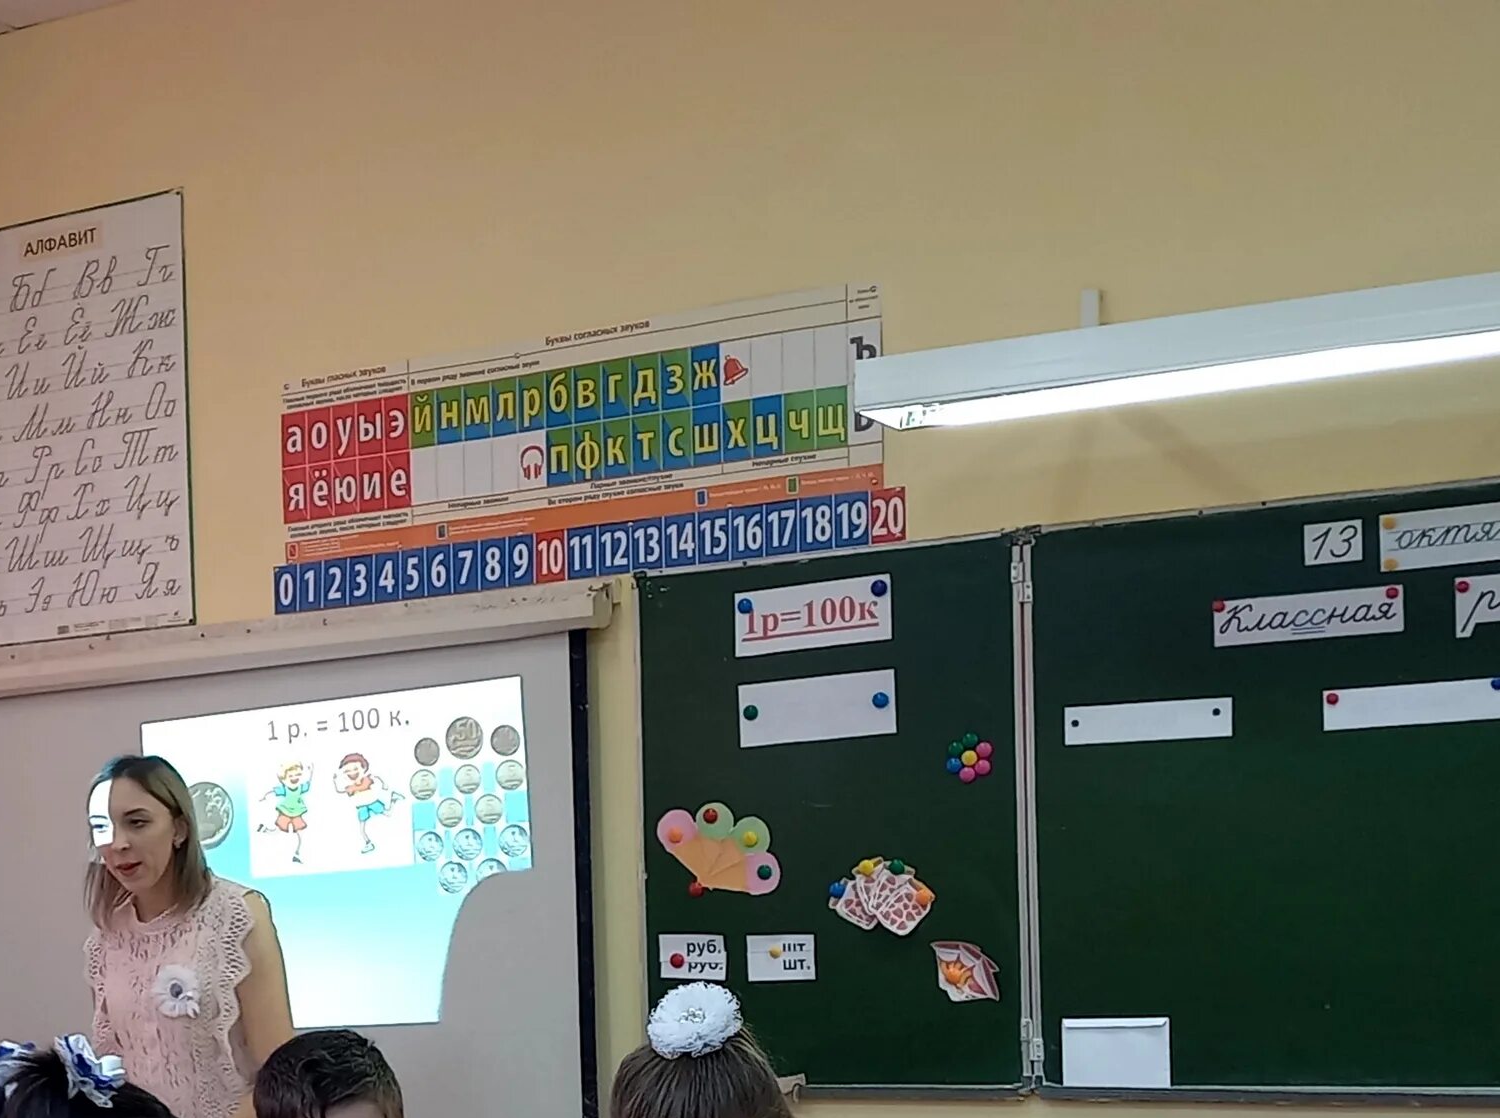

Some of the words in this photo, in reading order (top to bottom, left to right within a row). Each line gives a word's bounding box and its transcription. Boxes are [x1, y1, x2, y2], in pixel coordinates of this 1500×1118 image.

[24, 228, 96, 257] АЛФАВИТ
[10, 268, 57, 312] Бб
[72, 256, 117, 299] Вв
[137, 245, 173, 287] Гг
[18, 317, 47, 354] Ее
[64, 302, 92, 345] Ёё
[105, 295, 176, 338] Жж
[5, 362, 50, 400] Ии
[62, 346, 109, 389] Йй
[127, 339, 176, 379] Кк
[13, 403, 75, 442] Мм
[87, 390, 132, 429] Нн
[145, 382, 176, 420] Оо
[414, 394, 431, 434] й
[441, 402, 458, 429] н
[466, 397, 489, 425] м
[497, 392, 513, 422] л
[523, 388, 541, 427] р
[549, 372, 566, 412] б
[577, 380, 597, 408] в
[607, 374, 621, 403] г
[633, 368, 656, 407] д
[666, 364, 684, 394] з
[692, 359, 717, 390] ж
[286, 425, 302, 453] а
[311, 422, 328, 449] о
[337, 418, 353, 455] у
[360, 412, 381, 442] ы
[389, 409, 405, 438] э
[550, 445, 568, 474] п
[576, 432, 599, 479] ф
[607, 437, 625, 466] к
[637, 432, 654, 460] т
[668, 428, 683, 456] с
[693, 423, 719, 454] ш
[727, 419, 746, 449] х
[756, 414, 778, 450] ц
[788, 408, 809, 439] ч
[817, 404, 845, 442] щ
[25, 446, 64, 500] Рр
[75, 439, 103, 476] Сс
[114, 427, 178, 469] Тт
[14, 490, 59, 543] Фф
[67, 482, 110, 520] Хх
[124, 473, 180, 520] Цц
[289, 483, 304, 511] я
[313, 469, 329, 507] ё
[334, 477, 357, 504] ю
[363, 471, 381, 500] и
[390, 468, 406, 496] е
[5, 533, 68, 572] Шш
[79, 523, 152, 569] Щщ
[280, 573, 294, 606] 0
[304, 570, 314, 602] 1
[328, 567, 342, 599] 2
[353, 564, 367, 596] 3
[379, 561, 395, 593] 4
[406, 557, 419, 591] 5
[431, 553, 445, 587] 6
[459, 550, 473, 584] 7
[485, 547, 500, 581] 8
[513, 543, 529, 578] 9
[538, 539, 563, 574] 10
[570, 534, 591, 570] 11
[601, 531, 627, 568] 12
[634, 527, 659, 564] 13
[666, 522, 694, 559] 14
[700, 518, 726, 555] 15
[733, 514, 761, 550] 16
[768, 510, 796, 547] 17
[802, 505, 831, 543] 18
[837, 500, 867, 540] 19
[872, 495, 905, 536] 20
[1312, 525, 1357, 560] 13
[25, 577, 52, 613] Ээ
[67, 570, 118, 608] Юю
[135, 562, 181, 599] Яя
[744, 596, 878, 637] 1р=100к
[1220, 602, 1396, 634] Классная
[268, 721, 278, 740] 1
[287, 722, 307, 743] р.
[317, 720, 327, 731] =
[339, 708, 379, 732] 100
[390, 710, 409, 727] к.
[687, 940, 721, 956] руб.
[783, 960, 811, 970] шт.
